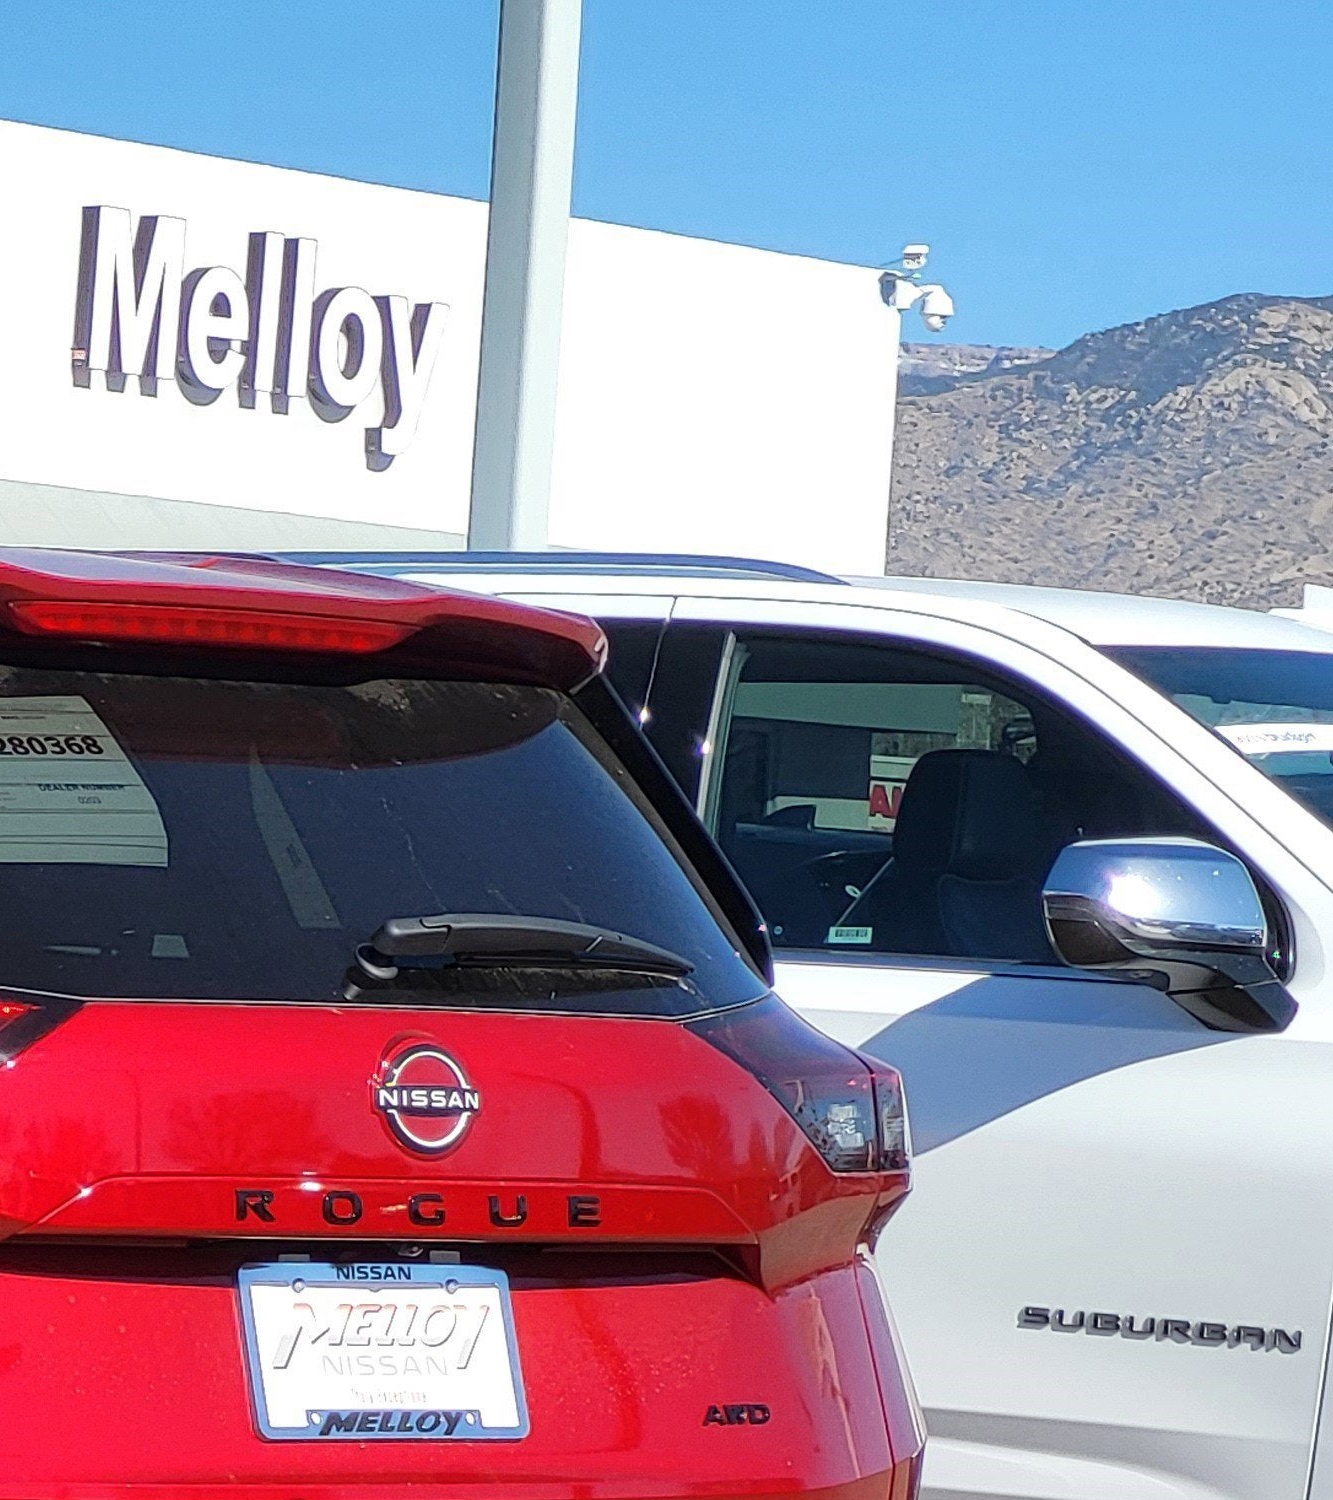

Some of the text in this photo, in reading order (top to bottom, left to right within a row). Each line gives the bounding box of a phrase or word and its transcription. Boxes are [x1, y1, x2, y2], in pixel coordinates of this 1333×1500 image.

[71, 205, 451, 472] Melloy
[379, 1088, 479, 1109] NISSAN
[235, 1189, 603, 1228] ROGUE
[336, 1265, 412, 1281] NISSAN
[272, 1302, 491, 1370] MELLOY
[1017, 1305, 1303, 1354] SUBURBAN
[322, 1354, 449, 1376] NISSAN
[318, 1410, 464, 1436] MELLOY
